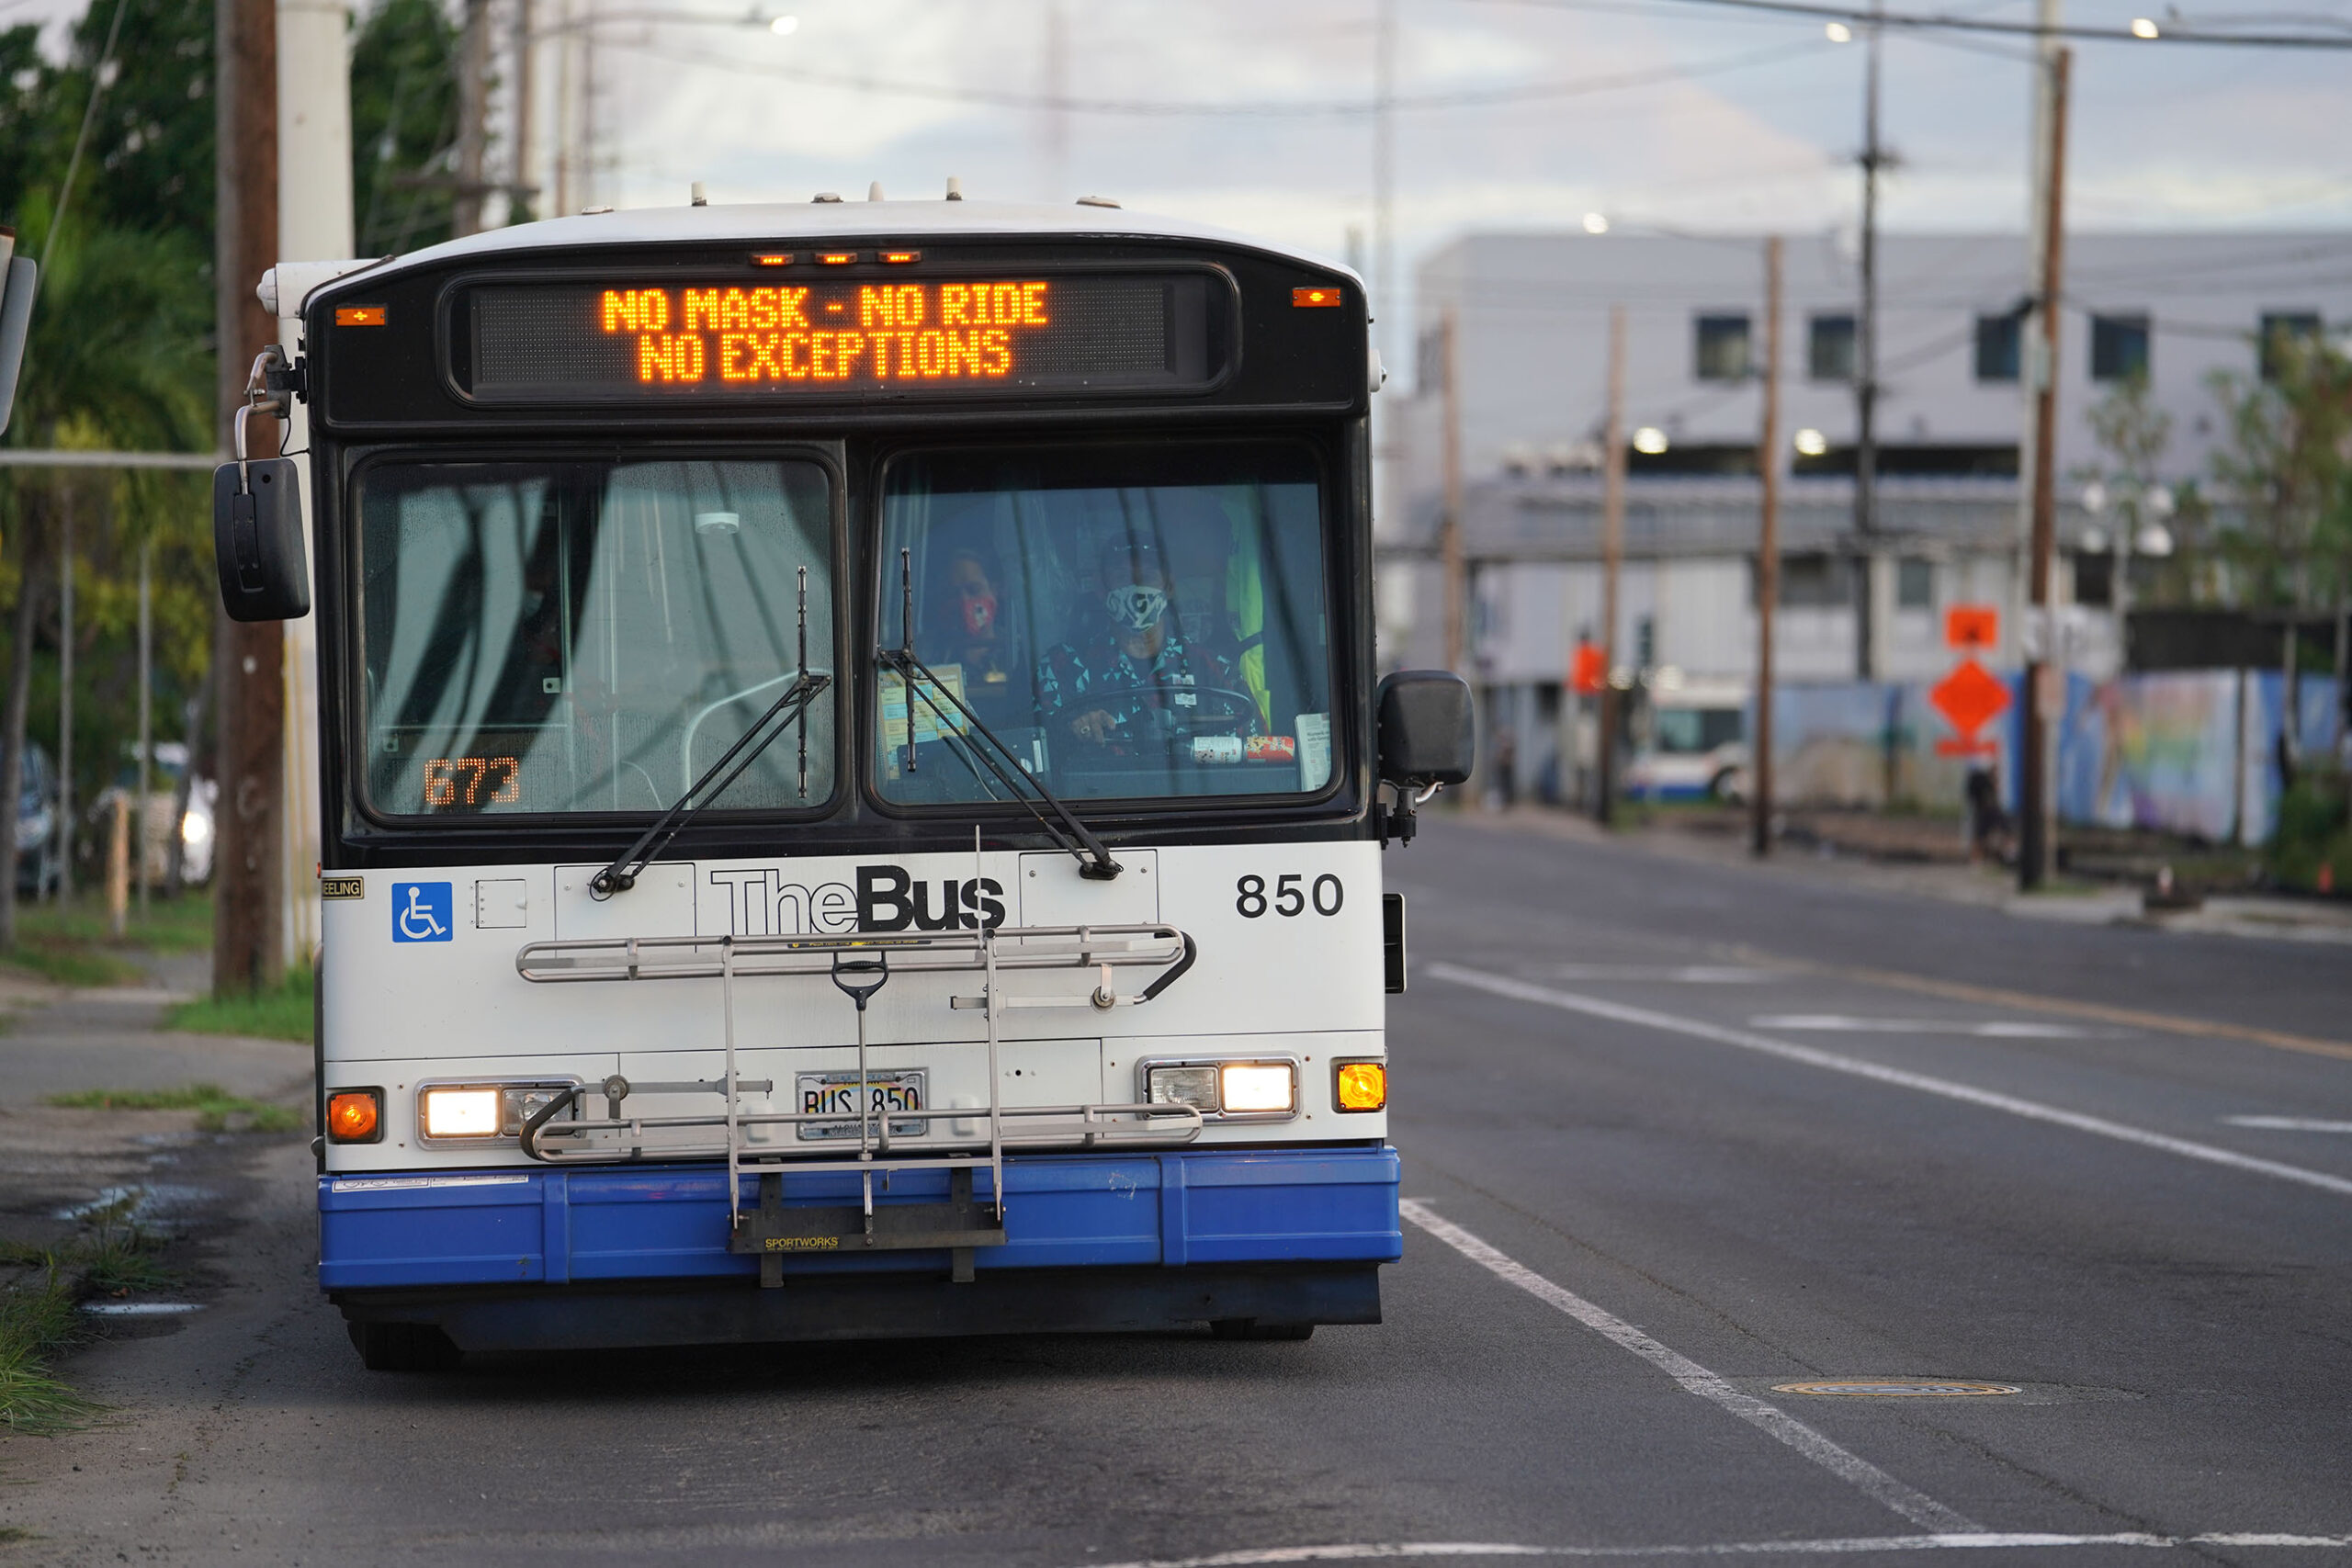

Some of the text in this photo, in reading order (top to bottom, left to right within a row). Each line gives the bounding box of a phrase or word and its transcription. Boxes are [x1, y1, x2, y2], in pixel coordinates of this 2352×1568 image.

[603, 288, 669, 332] NO
[685, 286, 808, 331] MASK
[861, 284, 924, 327] NO
[941, 281, 1049, 326] RIDE
[639, 329, 1012, 380] NO EXCEPTIONS
[424, 757, 519, 805] 673
[710, 864, 1006, 935] TheBus
[1236, 874, 1344, 919] 850
[871, 1087, 919, 1112] 850
[764, 1235, 840, 1248] SPORTWORKS
